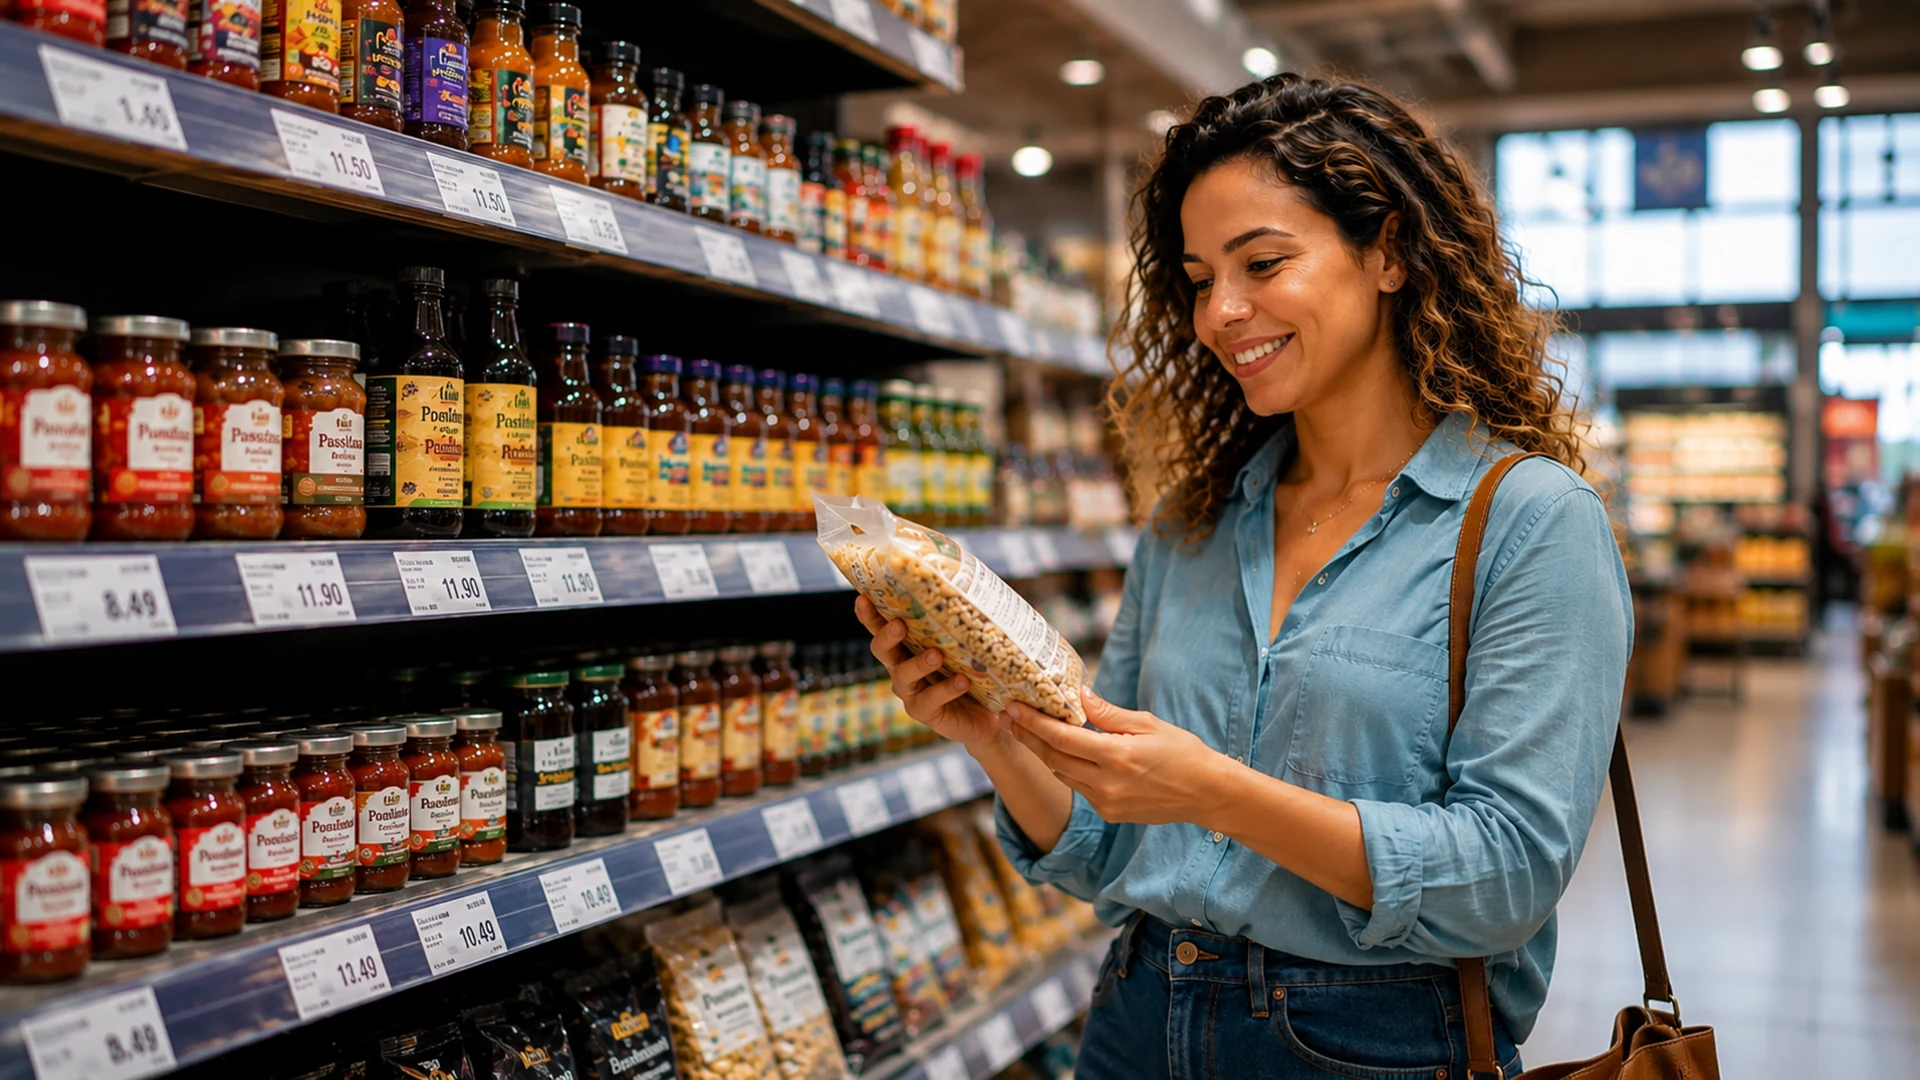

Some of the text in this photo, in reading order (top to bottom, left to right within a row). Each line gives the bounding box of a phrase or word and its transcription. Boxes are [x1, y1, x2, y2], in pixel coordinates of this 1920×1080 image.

[330, 151, 372, 180] 11.50
[472, 187, 506, 213] 11.50
[297, 582, 343, 608] 11.90
[442, 577, 480, 600] 11.90
[561, 573, 594, 593] 11.90
[102, 589, 157, 621] 8.49
[580, 884, 613, 910] 10.49
[459, 919, 496, 949] 10.49
